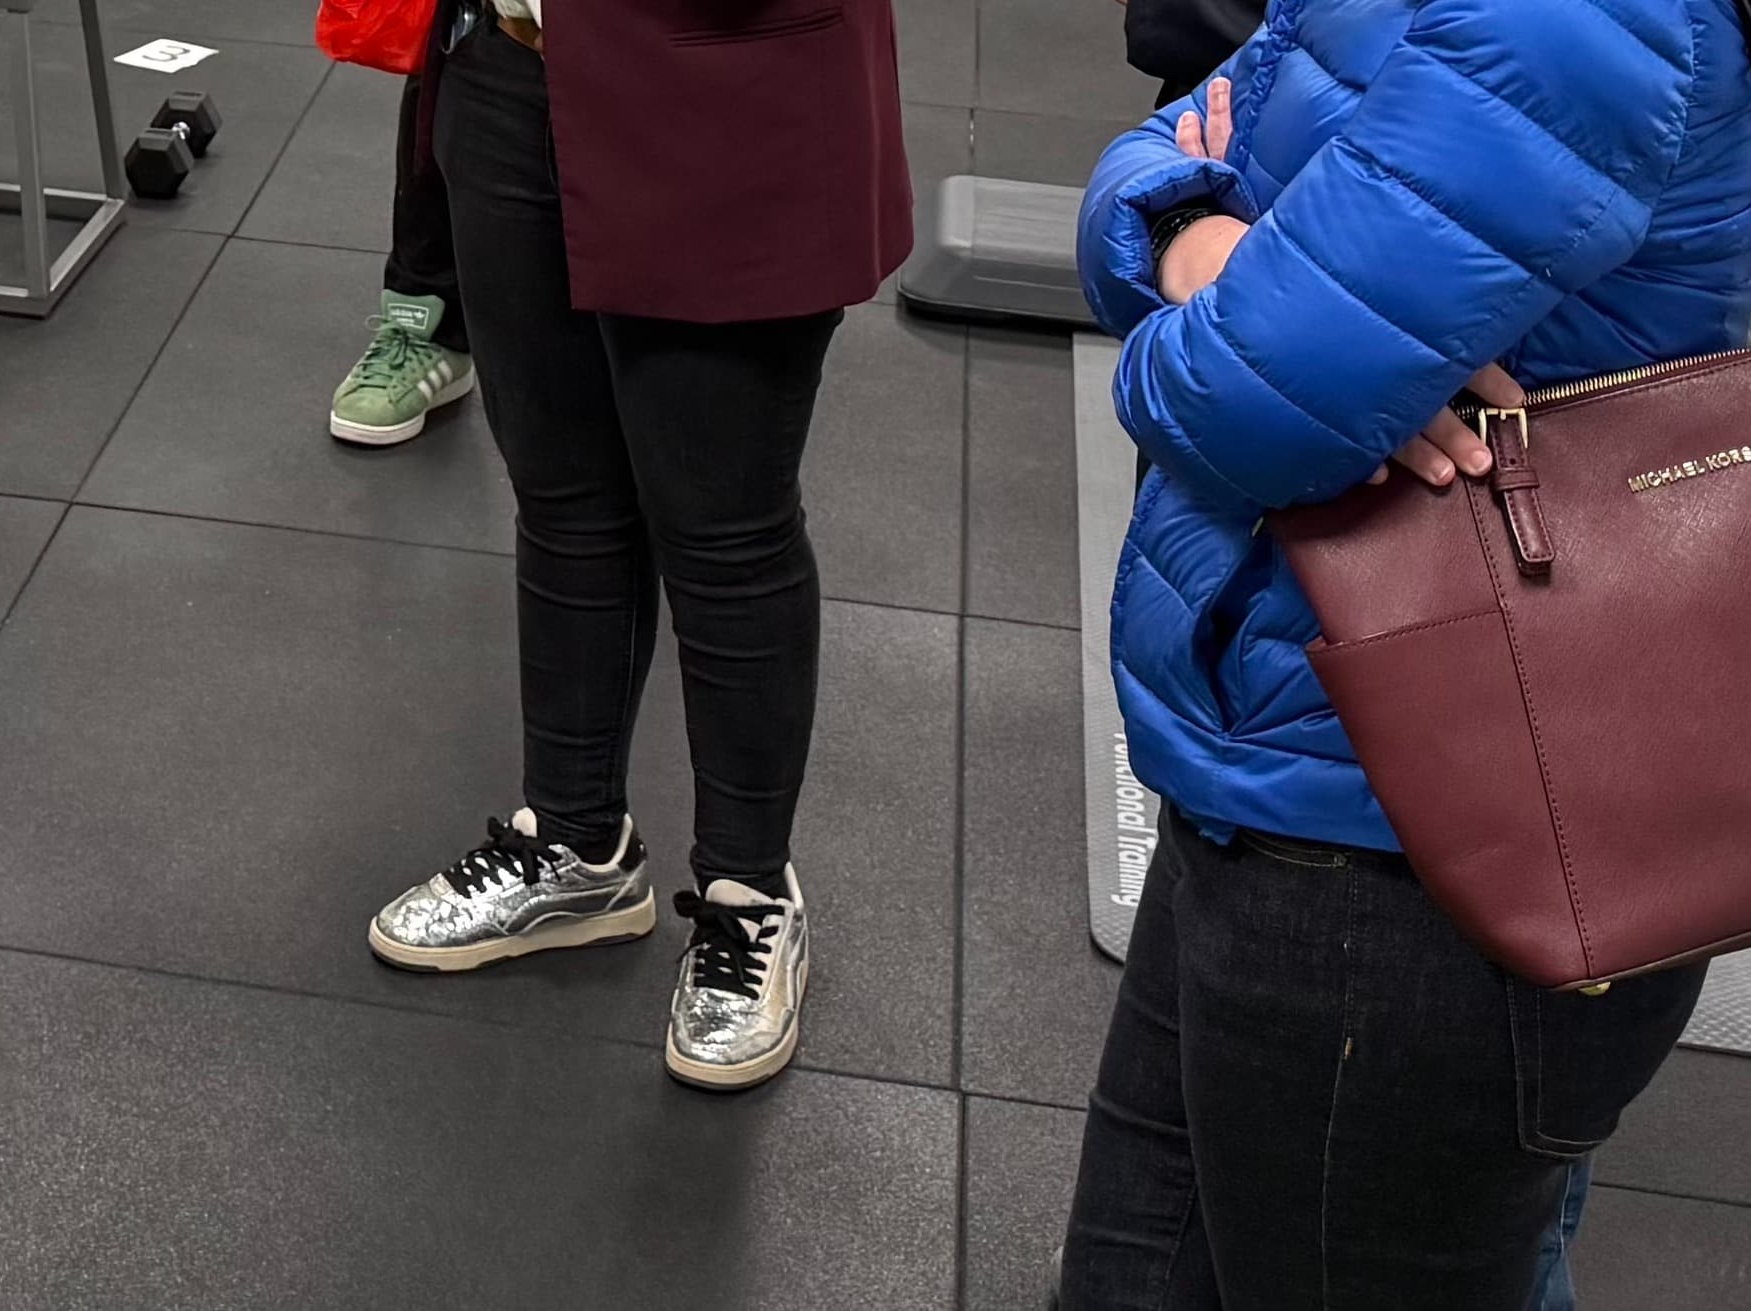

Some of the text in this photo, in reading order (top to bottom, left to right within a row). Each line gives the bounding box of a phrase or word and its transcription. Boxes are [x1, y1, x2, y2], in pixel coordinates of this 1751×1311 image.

[141, 45, 191, 62] 3
[1627, 445, 1751, 493] MICHAEL KORS
[1110, 835, 1156, 907] Training
